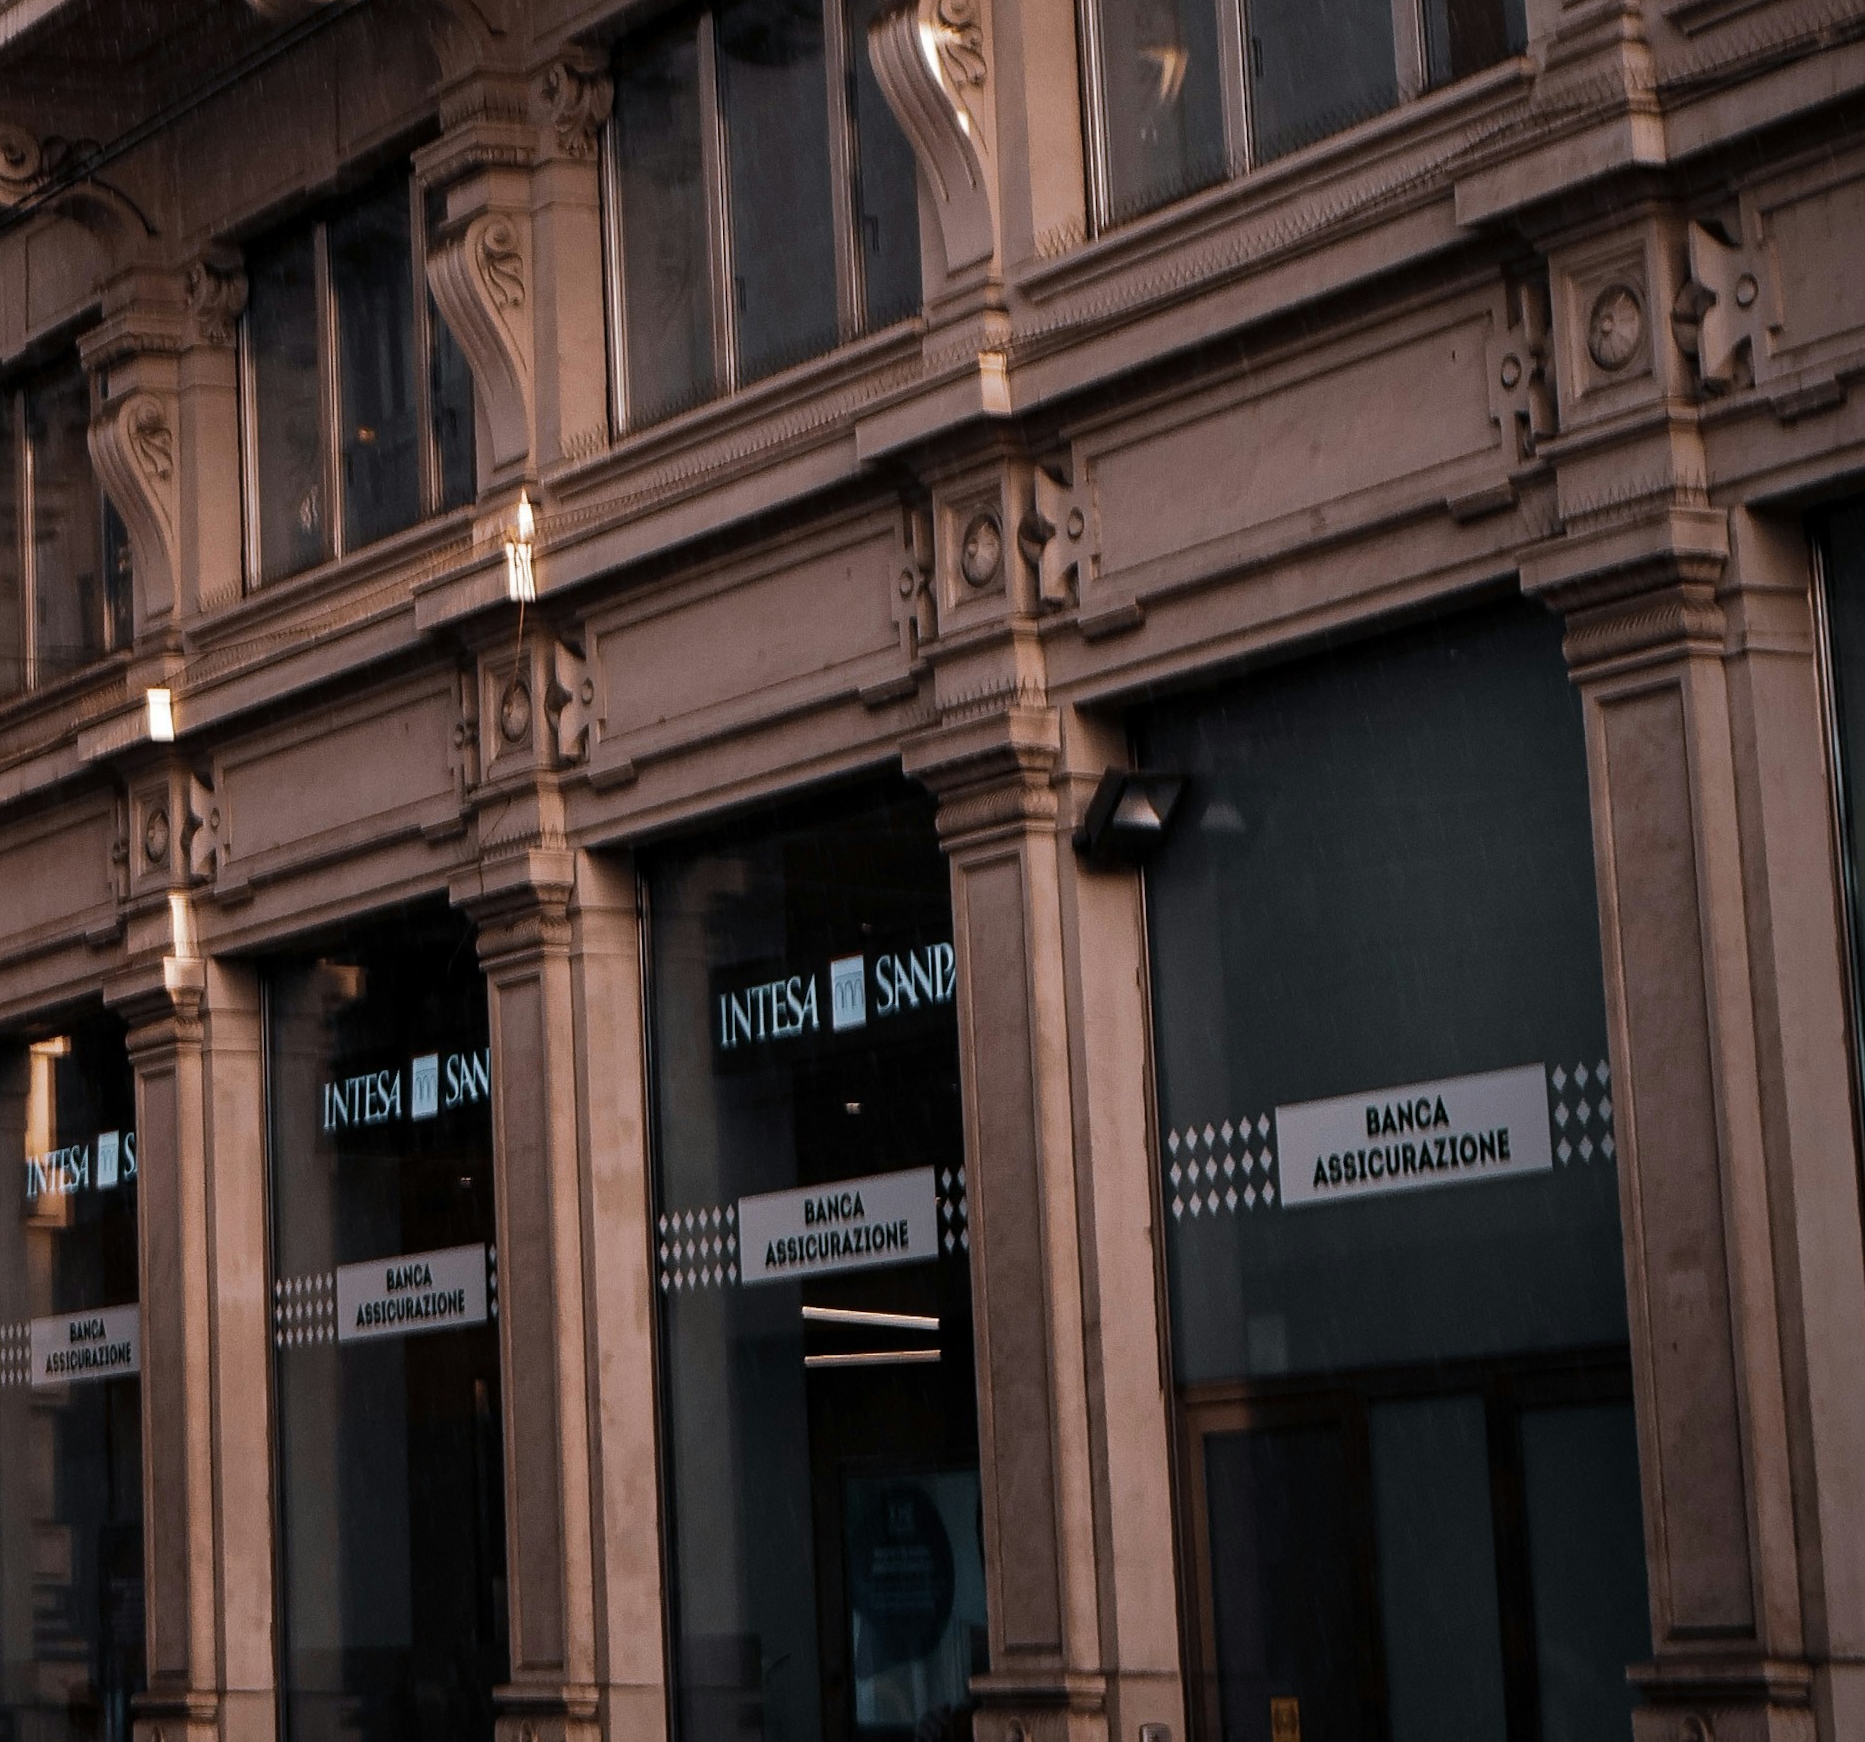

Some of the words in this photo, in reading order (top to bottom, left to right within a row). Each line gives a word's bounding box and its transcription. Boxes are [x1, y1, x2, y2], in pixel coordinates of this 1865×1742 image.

[721, 973, 820, 1047] INTESA
[324, 1069, 401, 1131] INTESA
[1365, 1095, 1450, 1137] BANCA
[27, 1144, 90, 1198] INTESA
[124, 1132, 138, 1177] S
[1313, 1127, 1512, 1187] ASSICURAZIONE
[804, 1190, 865, 1225] BANCA
[765, 1219, 909, 1267] ASSICURAZIONE
[386, 1263, 433, 1291] BANCA
[356, 1289, 465, 1326] ASSICURAZIONE
[70, 1319, 106, 1343] BANCA
[46, 1342, 131, 1373] ASSICURAZIONE
